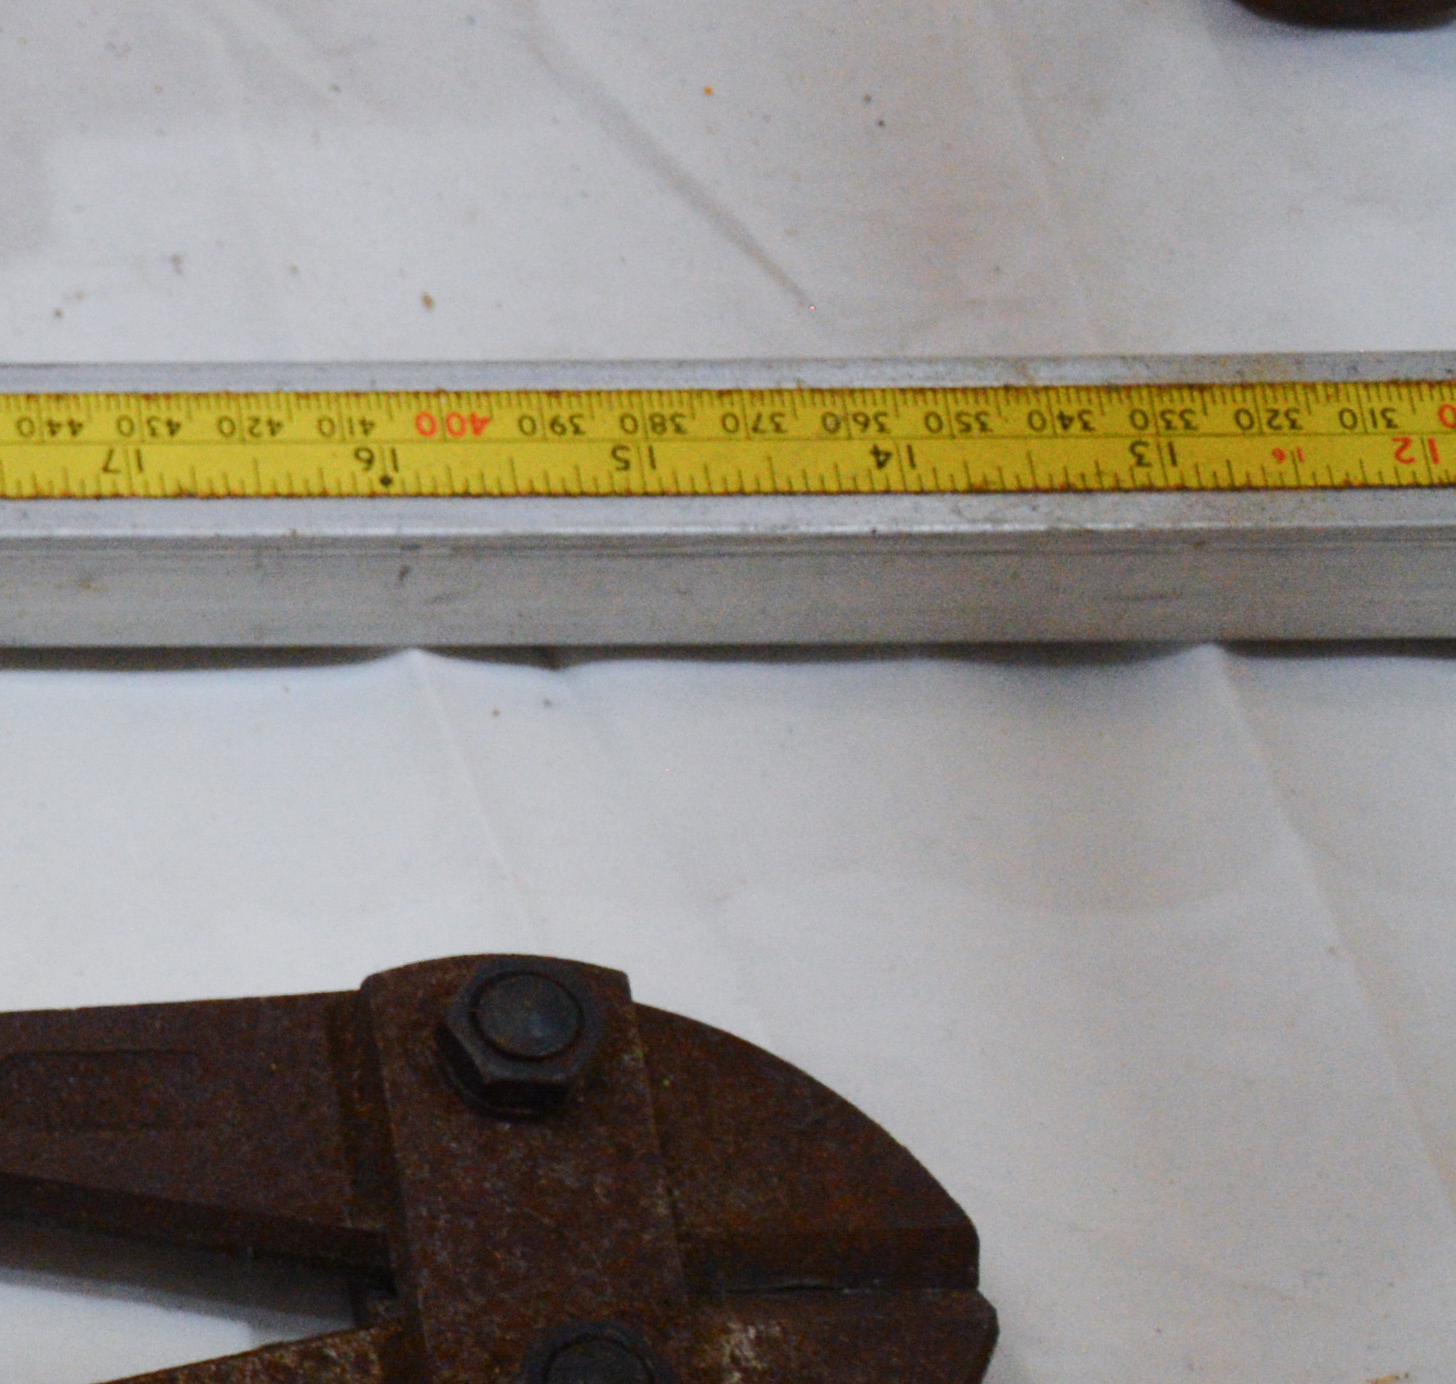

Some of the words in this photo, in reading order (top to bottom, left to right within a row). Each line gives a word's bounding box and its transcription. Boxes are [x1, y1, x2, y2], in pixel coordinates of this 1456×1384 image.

[101, 447, 144, 475] 17
[353, 446, 400, 473] 16
[610, 444, 658, 472] 15
[869, 443, 918, 471] 14
[1128, 439, 1179, 468] 13
[1392, 436, 1441, 465] 12
